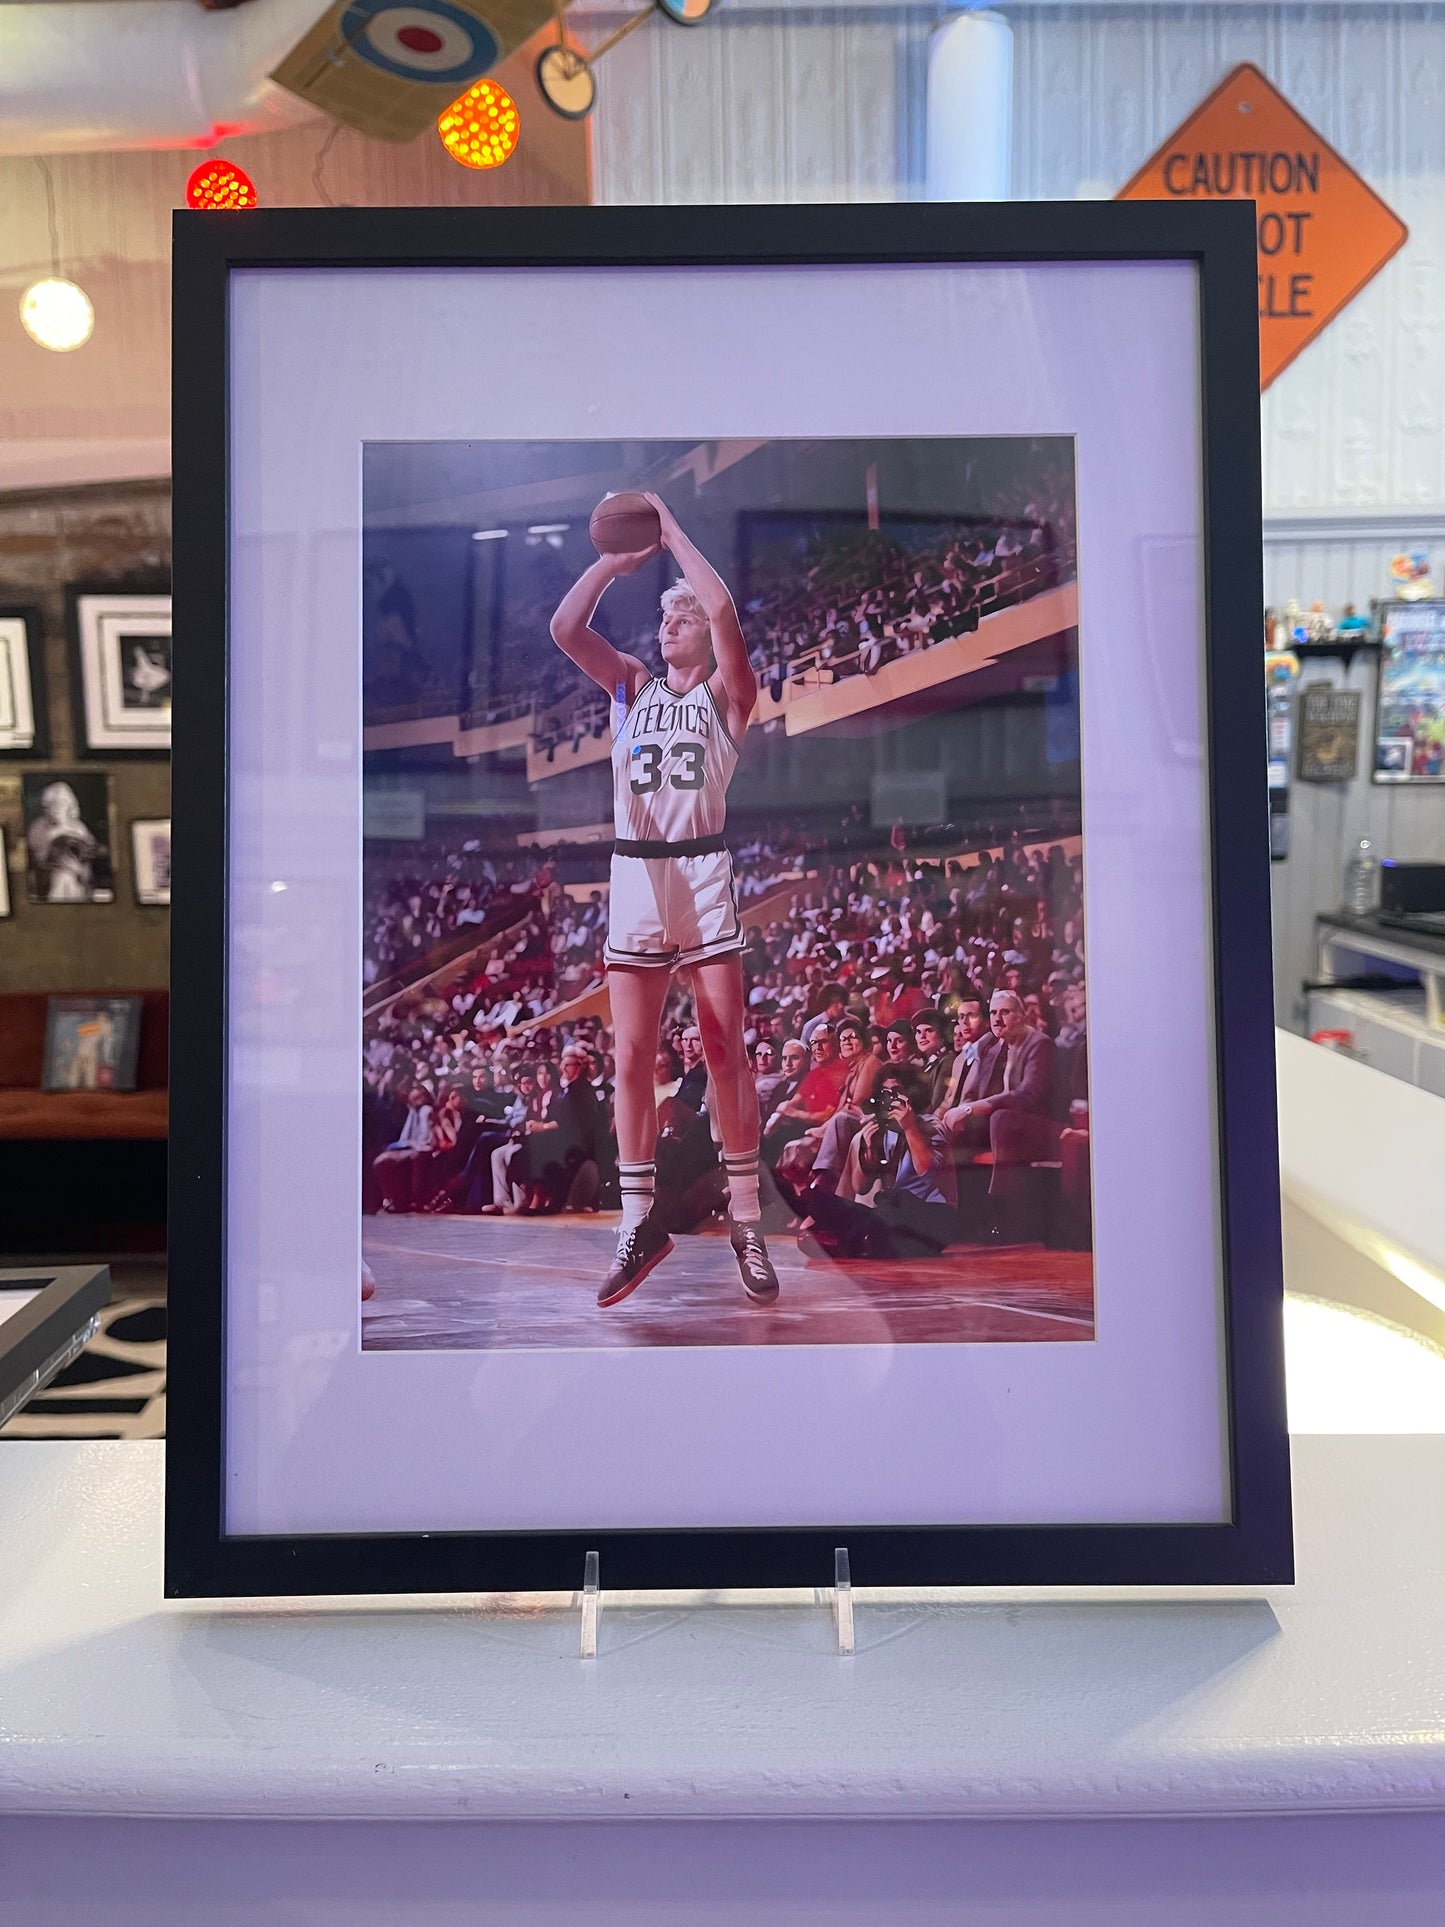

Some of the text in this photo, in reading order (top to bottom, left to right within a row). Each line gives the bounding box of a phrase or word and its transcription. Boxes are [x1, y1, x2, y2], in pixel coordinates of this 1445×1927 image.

[1163, 153, 1320, 195] CAUTION
[1258, 274, 1313, 318] LE
[632, 703, 709, 739] CELTICS
[630, 742, 705, 795] 33
